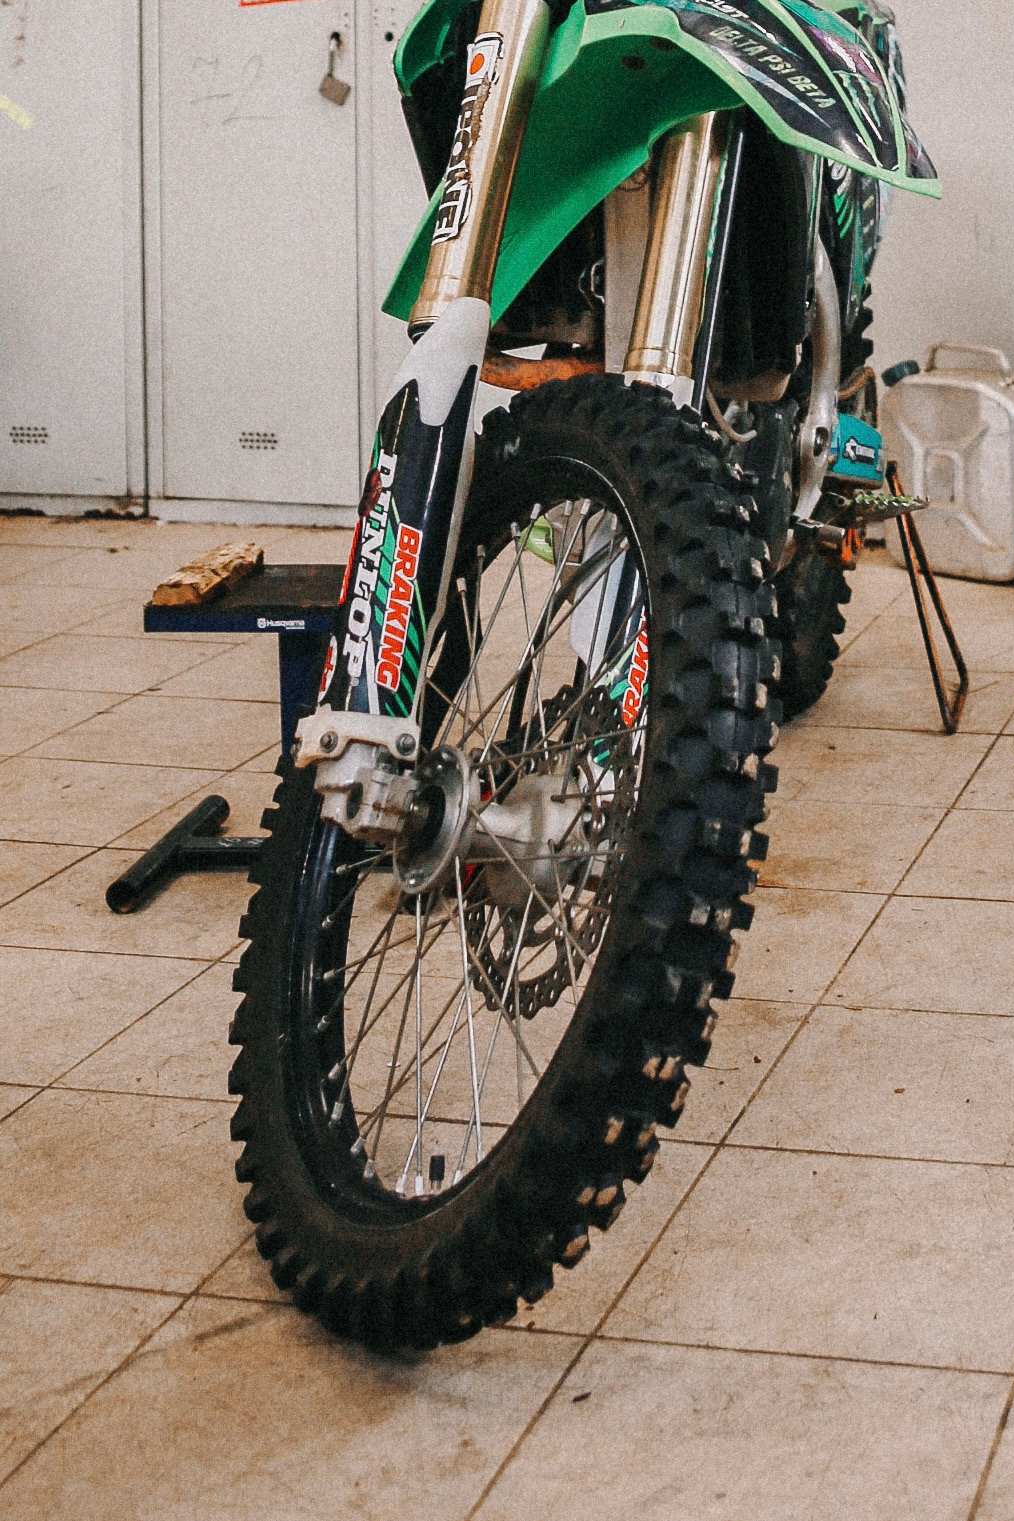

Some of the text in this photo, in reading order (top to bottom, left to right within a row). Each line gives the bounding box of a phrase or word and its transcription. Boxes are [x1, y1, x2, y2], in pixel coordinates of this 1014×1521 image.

[710, 25, 836, 109] DELTA PSI BETA
[343, 449, 398, 678] DUNLOP
[375, 522, 423, 691] BRAKING
